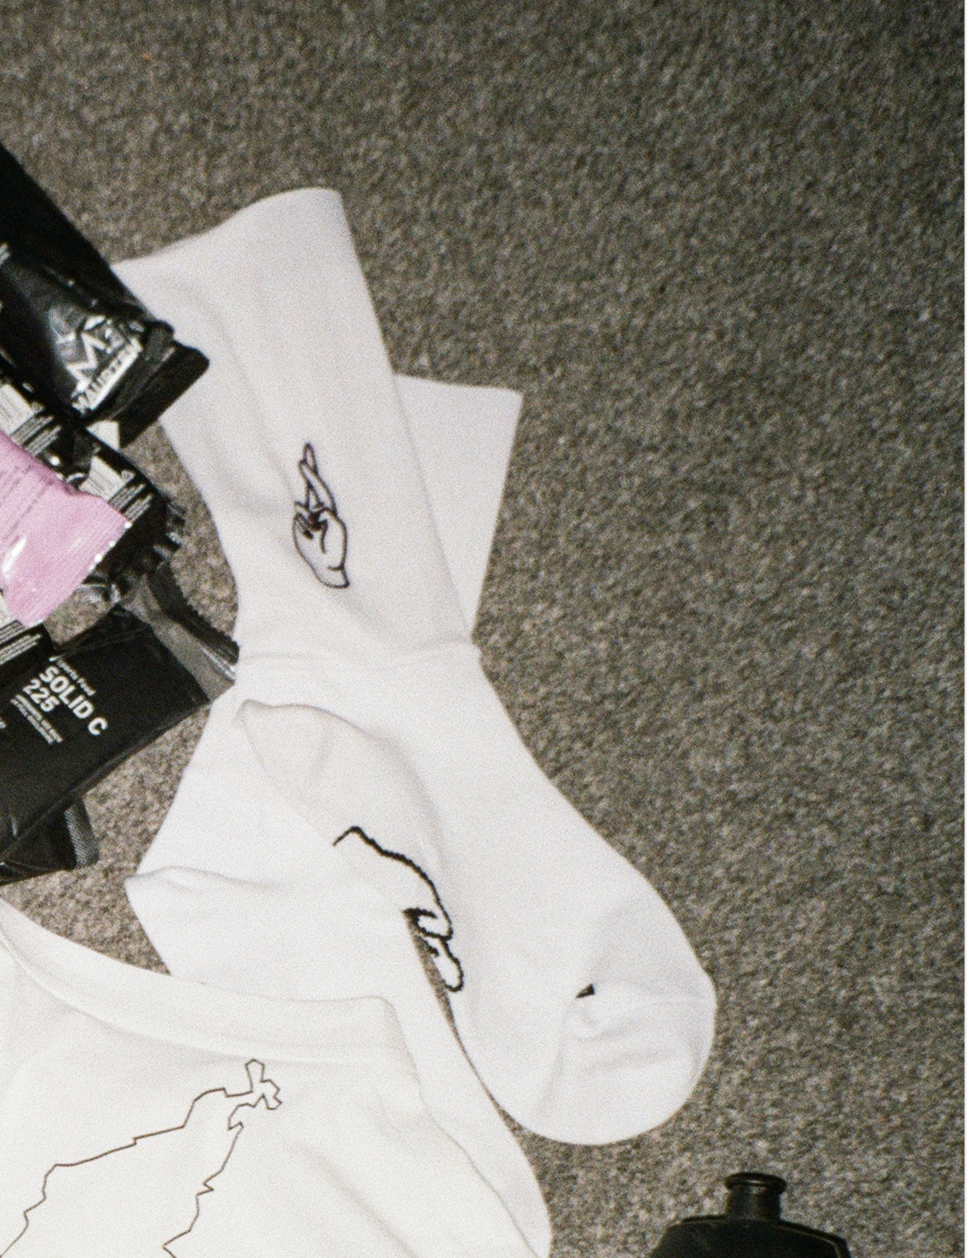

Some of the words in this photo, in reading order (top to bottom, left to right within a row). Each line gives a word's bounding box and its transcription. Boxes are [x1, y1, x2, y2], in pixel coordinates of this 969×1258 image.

[23, 679, 60, 712] 225
[39, 666, 94, 719] SOLID
[88, 717, 108, 735] C
